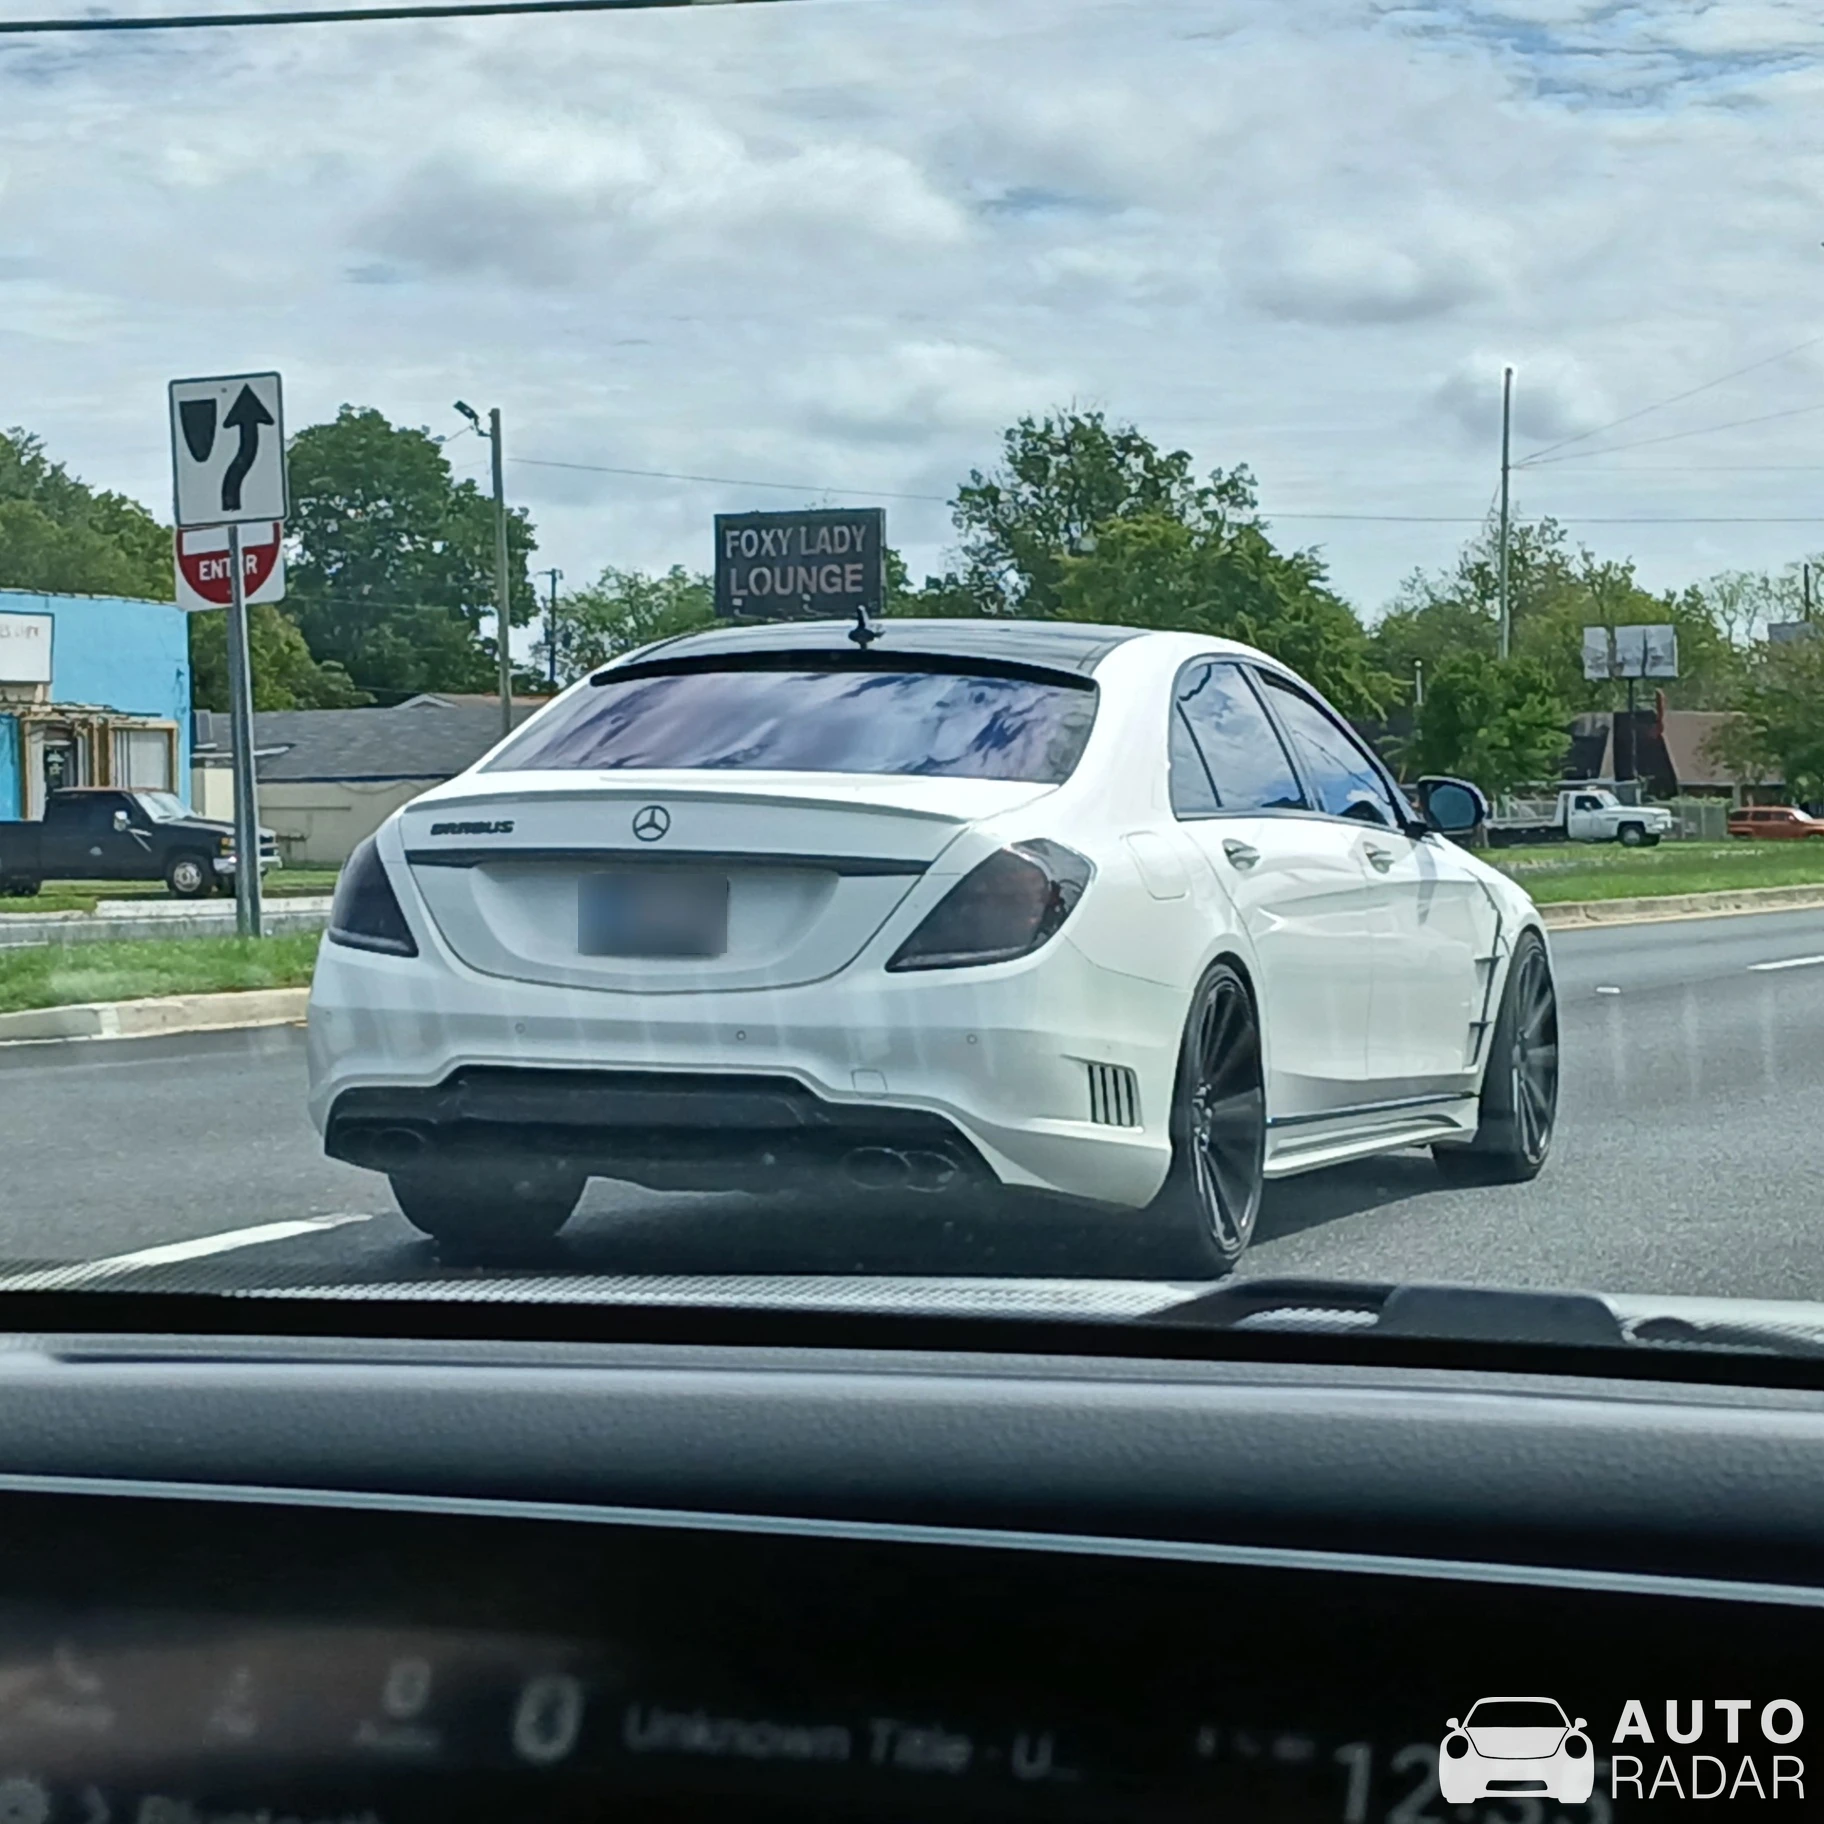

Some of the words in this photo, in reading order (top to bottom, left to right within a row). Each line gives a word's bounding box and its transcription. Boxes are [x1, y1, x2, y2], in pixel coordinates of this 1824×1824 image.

[725, 527, 793, 559] FOXY
[799, 524, 866, 556] LADY
[199, 554, 258, 581] ENTR
[730, 563, 864, 596] LOUNGE
